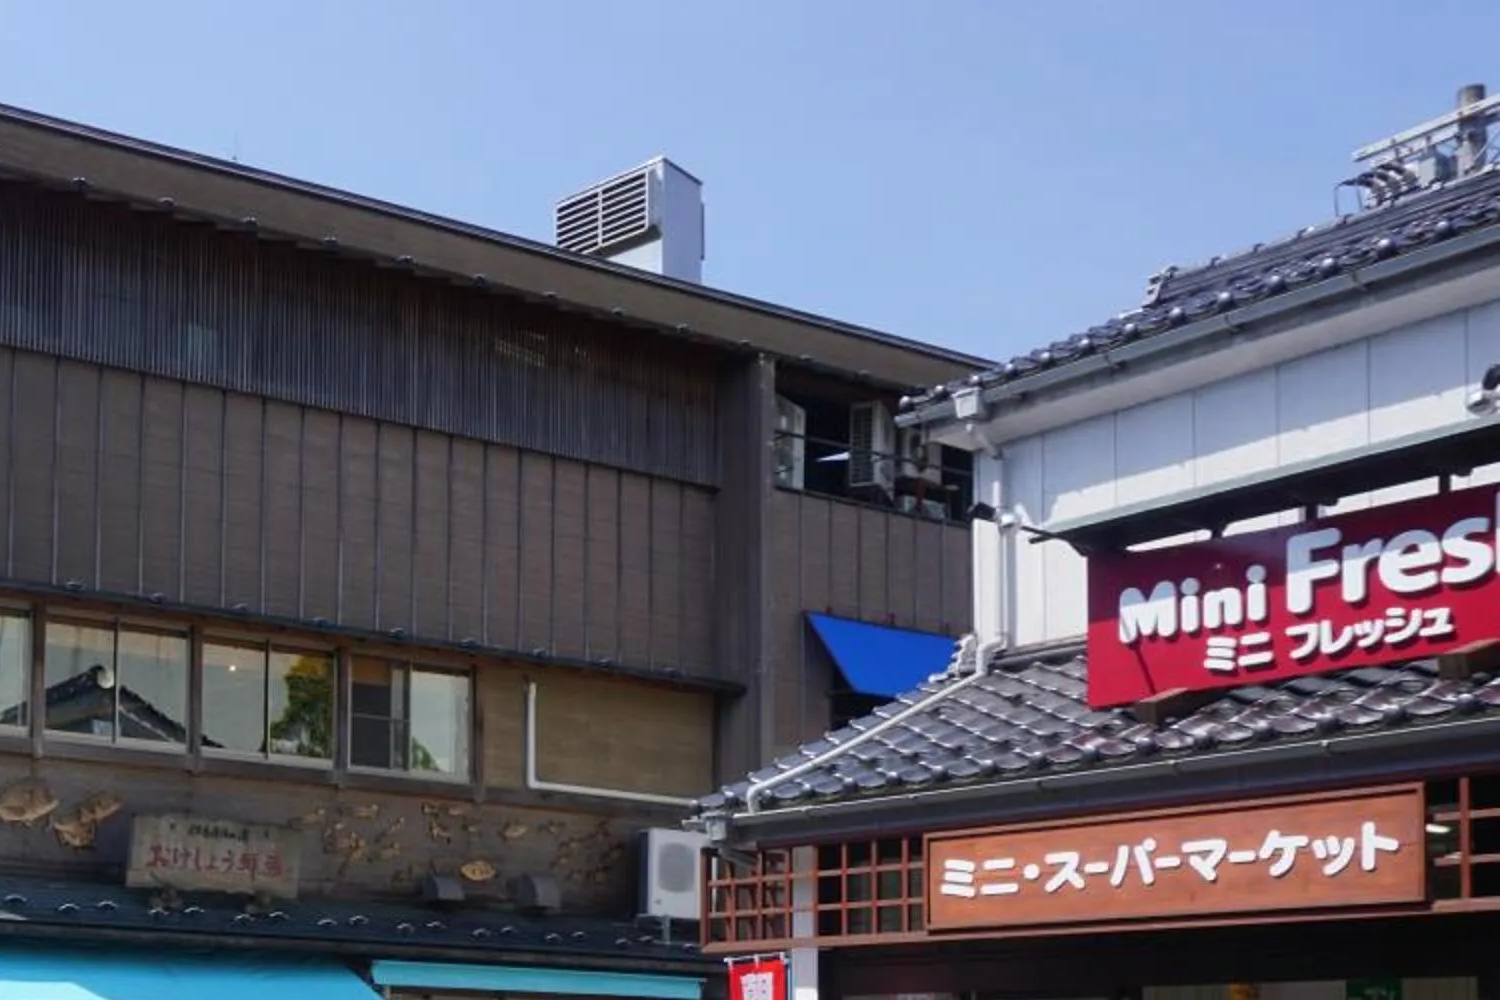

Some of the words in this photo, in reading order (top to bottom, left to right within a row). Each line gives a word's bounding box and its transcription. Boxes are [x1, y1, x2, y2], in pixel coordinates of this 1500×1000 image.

[1118, 563, 1267, 643] Mini
[1286, 493, 1500, 614] Fres
[1203, 630, 1274, 672] ミニ
[1285, 606, 1455, 661] フレッシュ
[939, 820, 1400, 899] ミニ・スーパーマーケット
